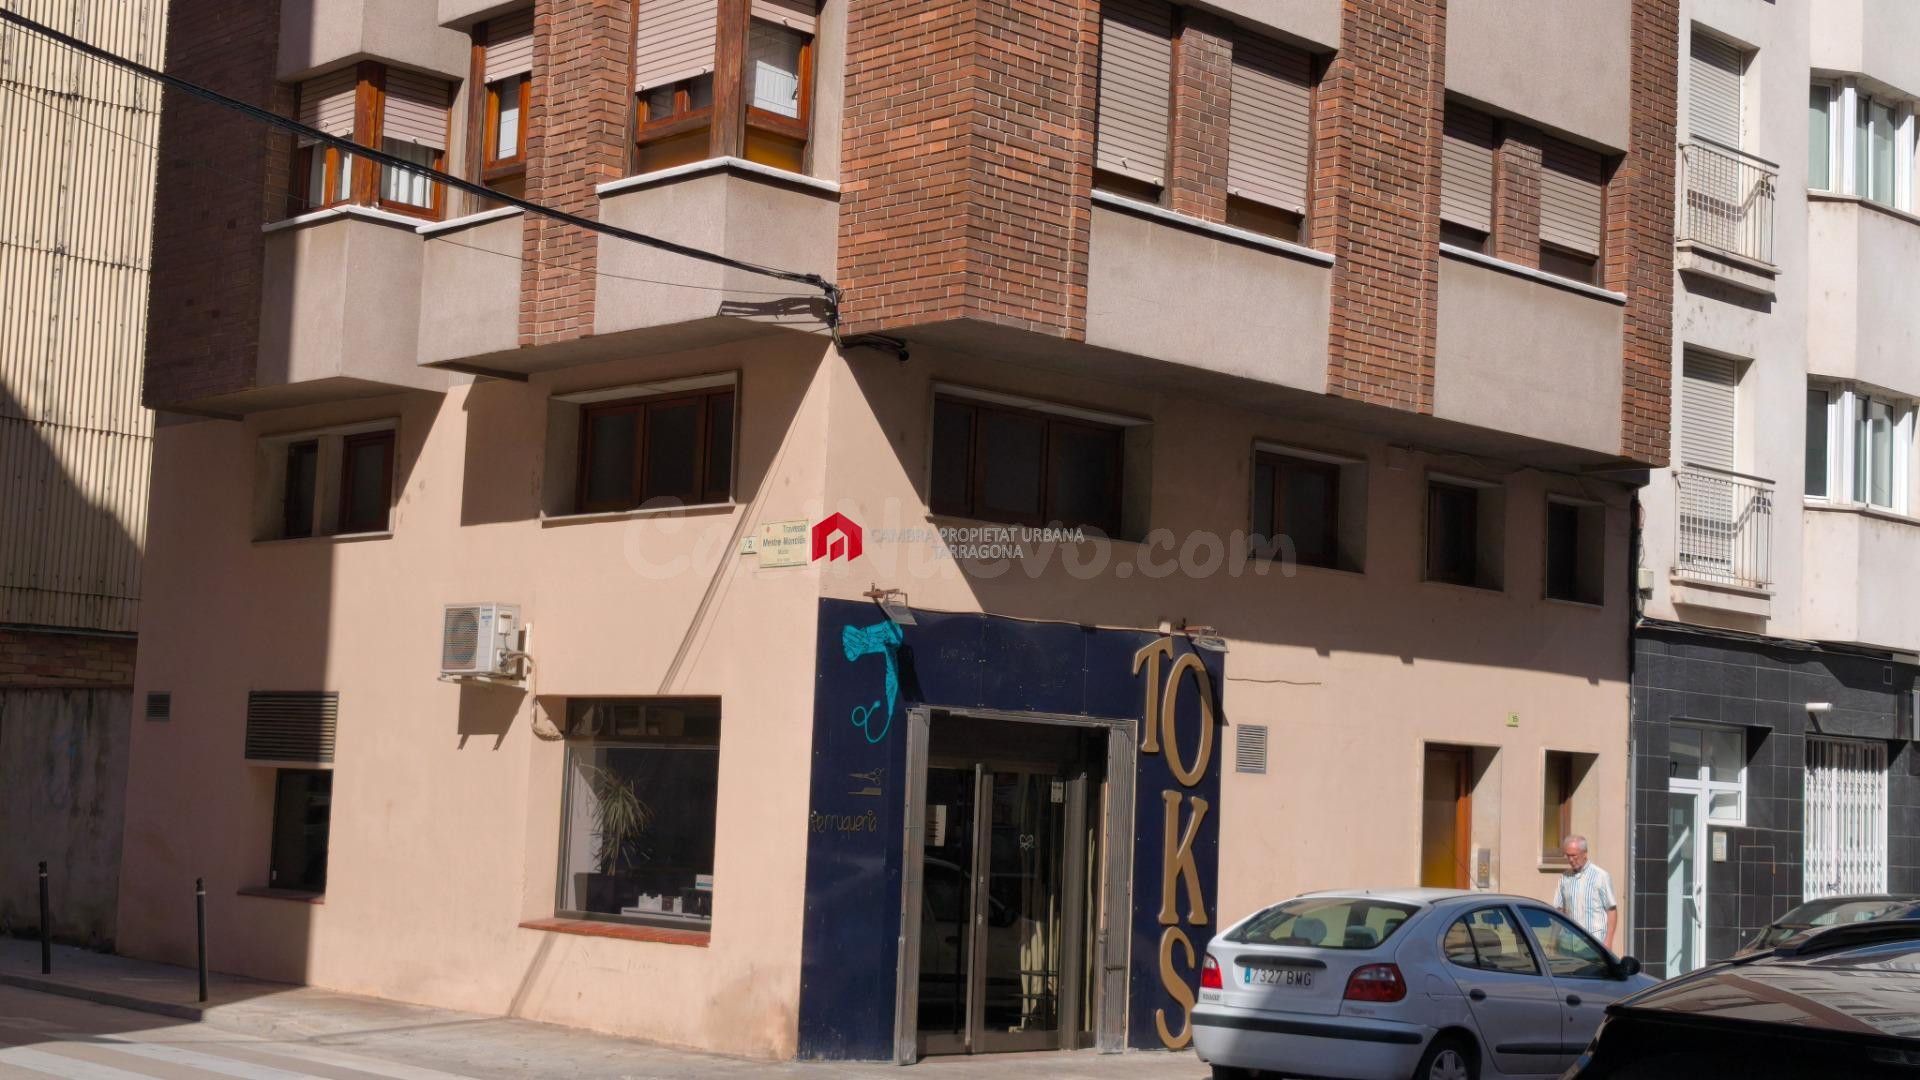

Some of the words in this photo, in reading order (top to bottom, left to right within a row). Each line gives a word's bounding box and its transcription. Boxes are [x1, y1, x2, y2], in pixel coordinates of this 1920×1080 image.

[1133, 636, 1214, 1050] TOKS
[1252, 968, 1282, 984] 7327
[1286, 970, 1311, 986] BMG
